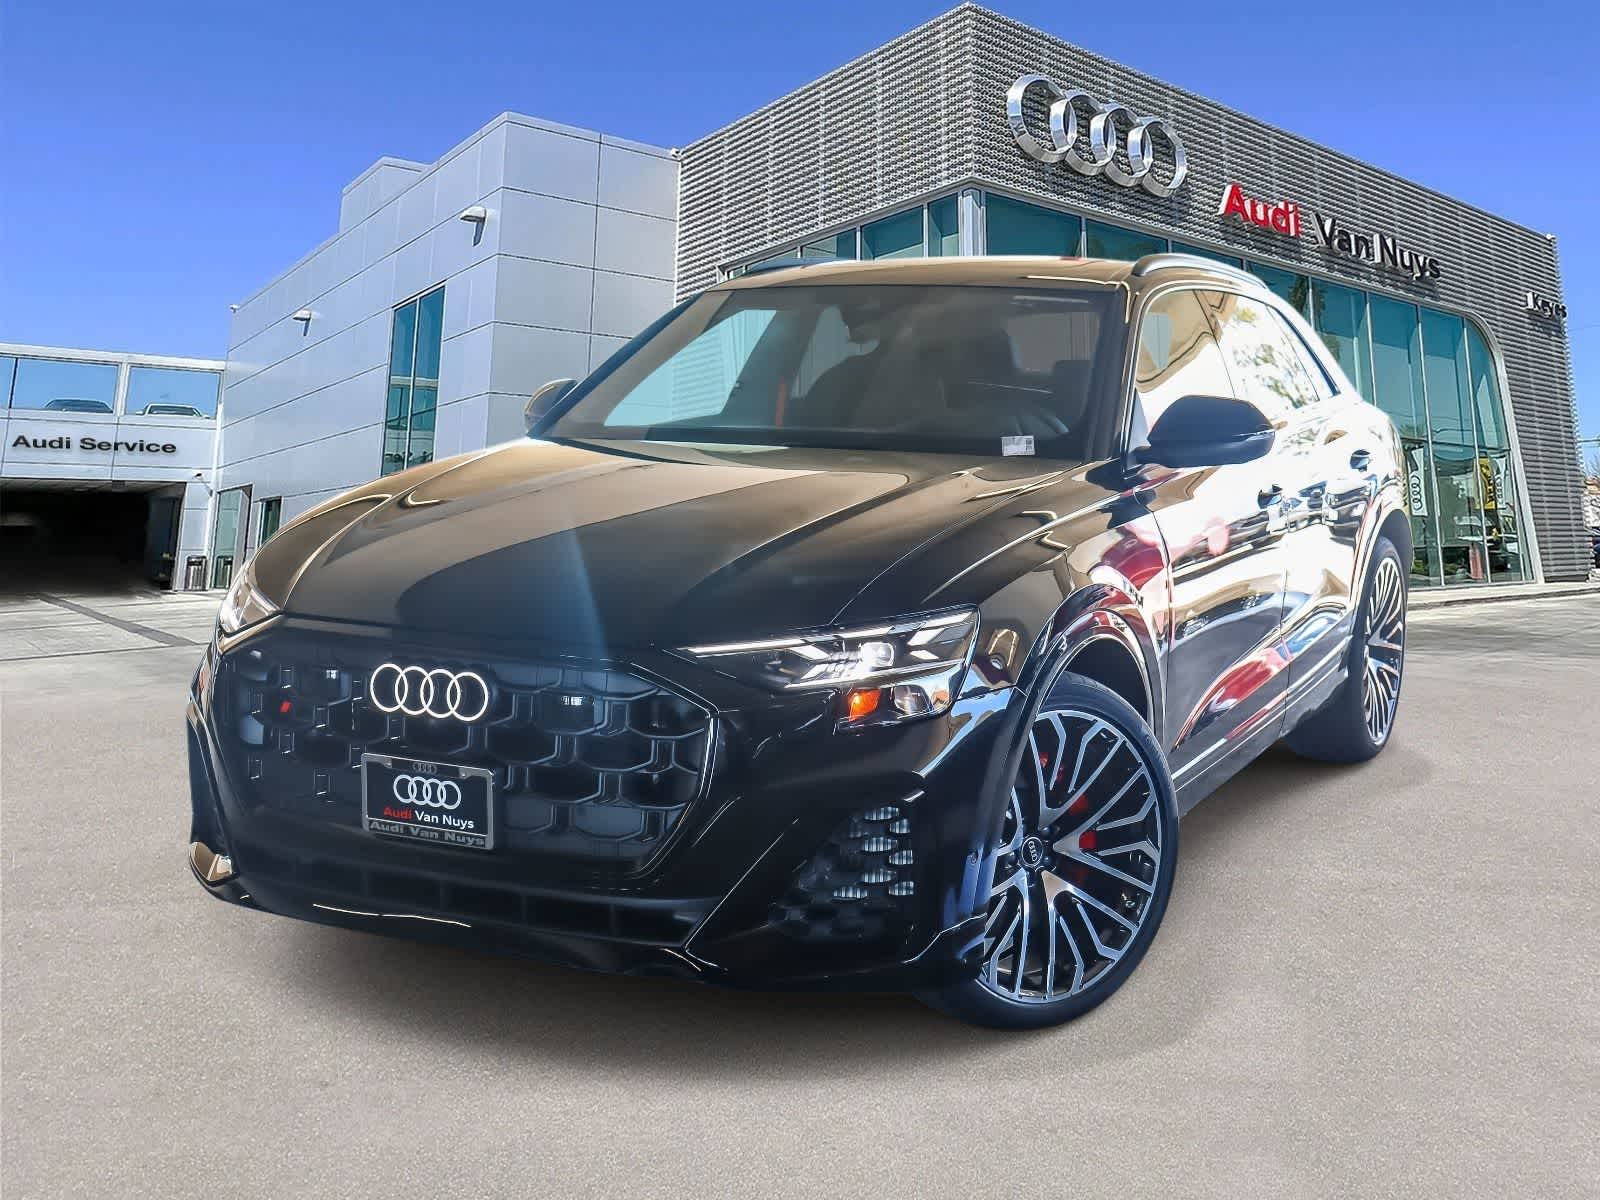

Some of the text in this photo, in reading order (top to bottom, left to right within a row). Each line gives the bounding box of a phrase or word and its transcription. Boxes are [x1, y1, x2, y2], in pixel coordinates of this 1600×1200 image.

[1218, 183, 1441, 280] Audi Van Nuys
[12, 435, 177, 453] Audi Service
[384, 808, 474, 829] Audi Van Nuys
[371, 821, 486, 846] Audi Van Nuys
